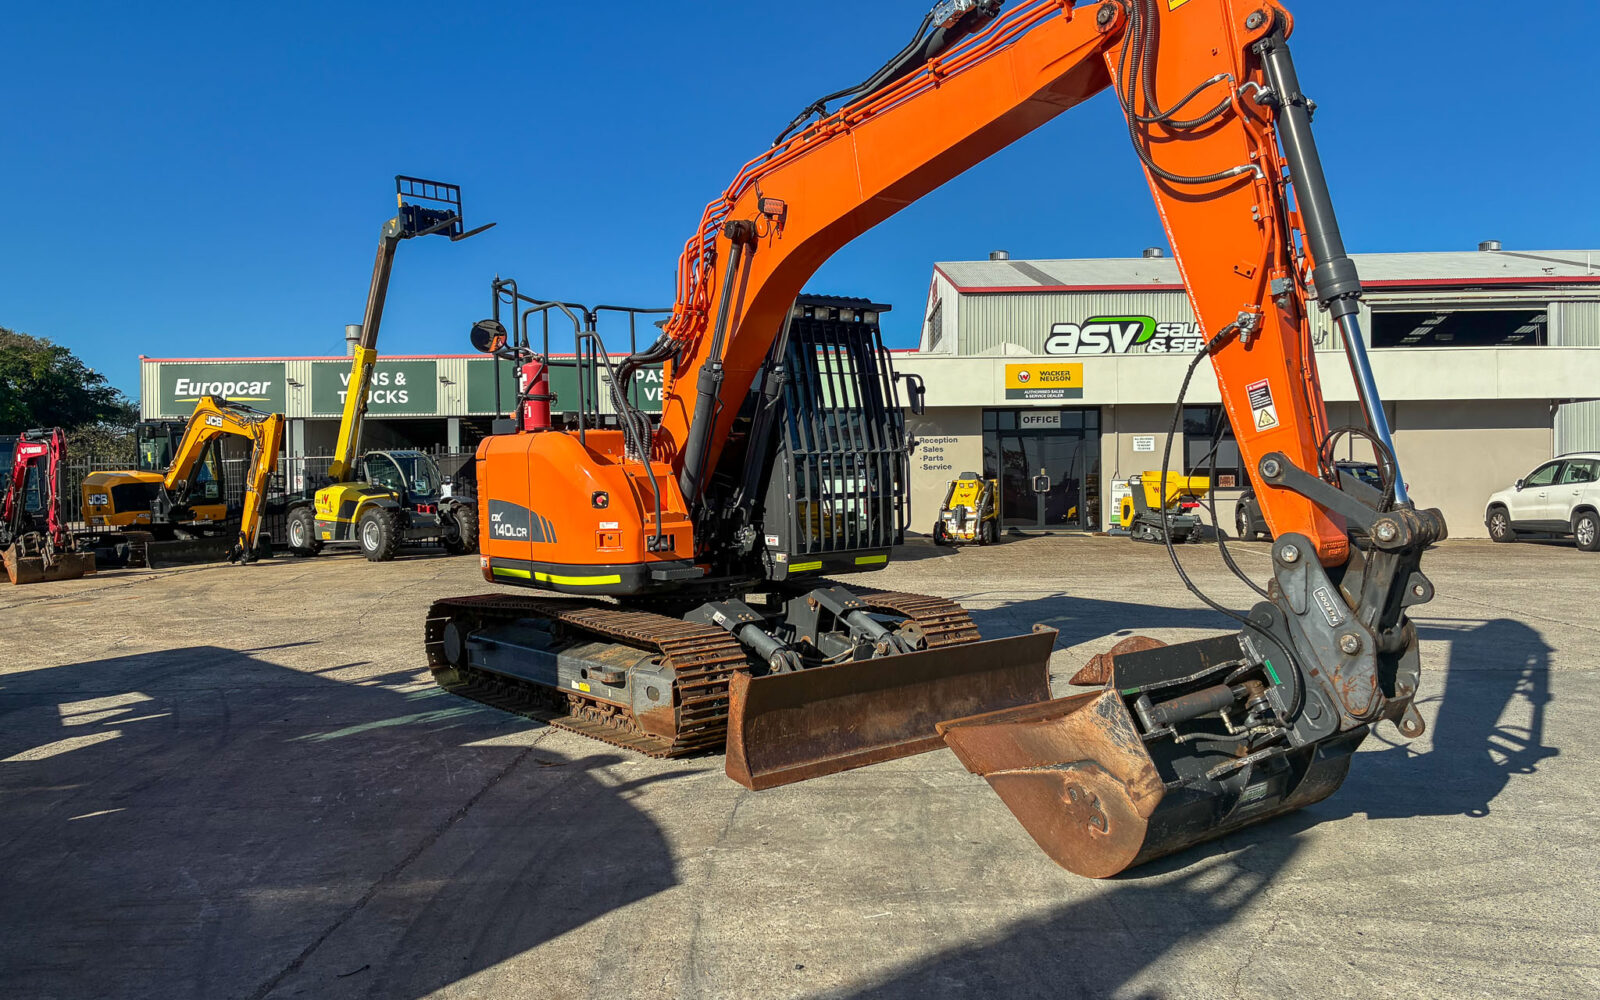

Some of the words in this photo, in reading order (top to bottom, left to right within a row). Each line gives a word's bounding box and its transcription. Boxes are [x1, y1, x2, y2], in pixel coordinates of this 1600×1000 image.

[1147, 338, 1167, 353] &
[339, 372, 389, 387] VNS
[394, 372, 407, 386] &
[174, 378, 271, 400] Europcar
[205, 415, 223, 427] JCB
[1023, 415, 1060, 424] OFFICE
[919, 436, 958, 444] Reception
[922, 454, 944, 462] Parts
[922, 463, 953, 471] Service
[88, 494, 108, 505] JCB
[494, 523, 528, 537] 140LCR
